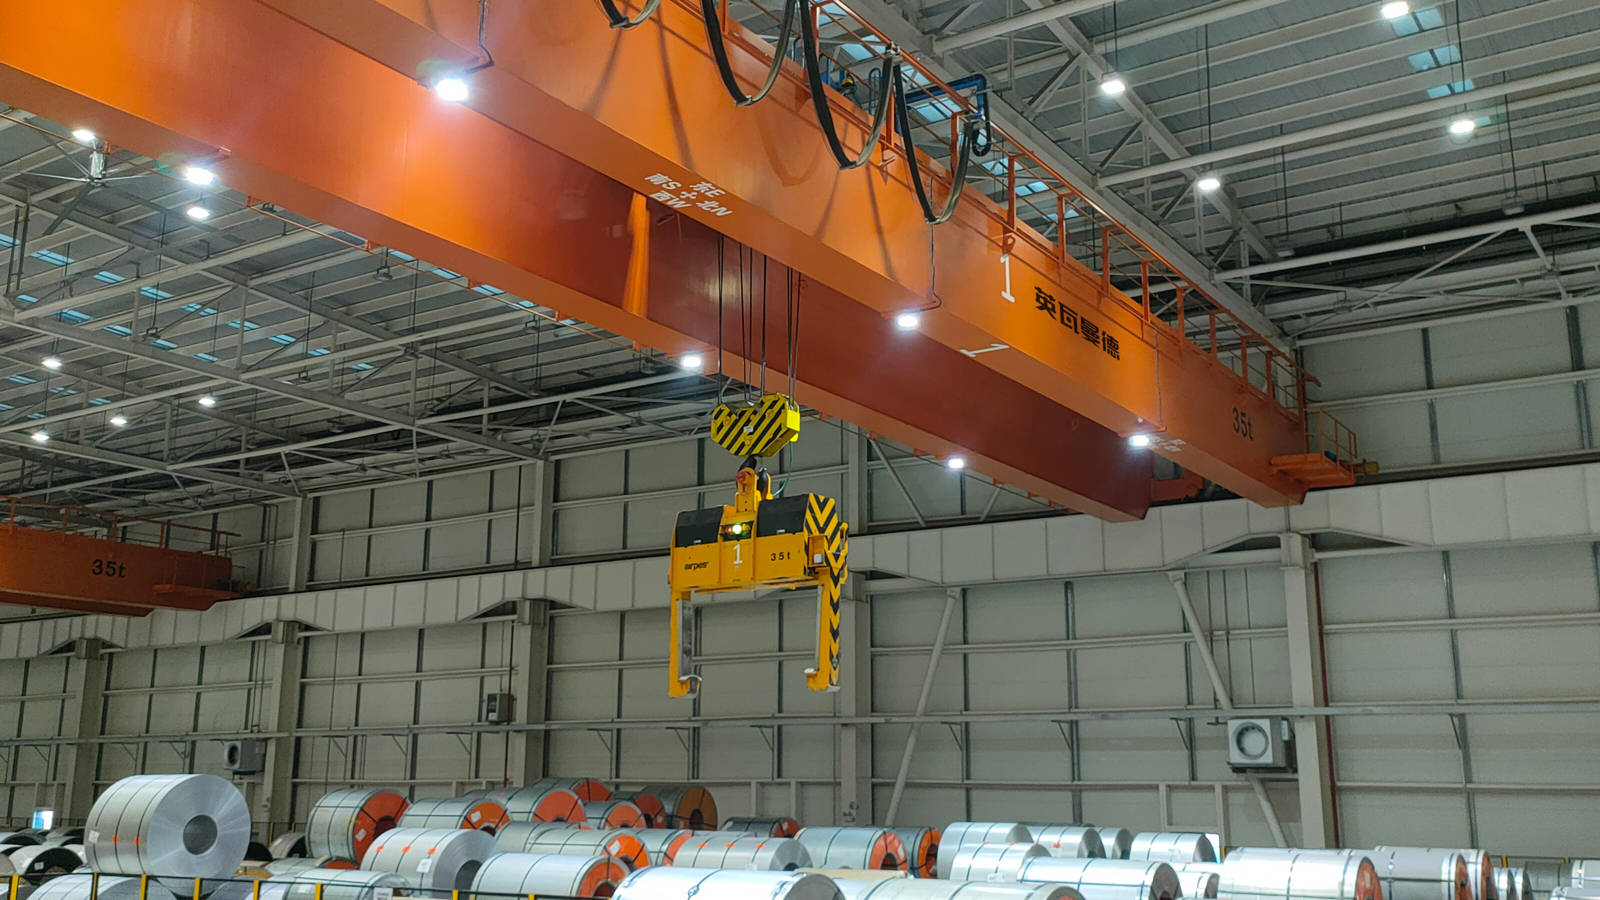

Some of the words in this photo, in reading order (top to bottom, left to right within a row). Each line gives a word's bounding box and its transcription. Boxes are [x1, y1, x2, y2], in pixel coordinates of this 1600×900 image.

[1000, 253, 1015, 303] 1
[1034, 286, 1120, 360] 英瓦曼德
[1232, 407, 1253, 440] 35t
[92, 559, 126, 578] 35t
[733, 543, 743, 565] 1
